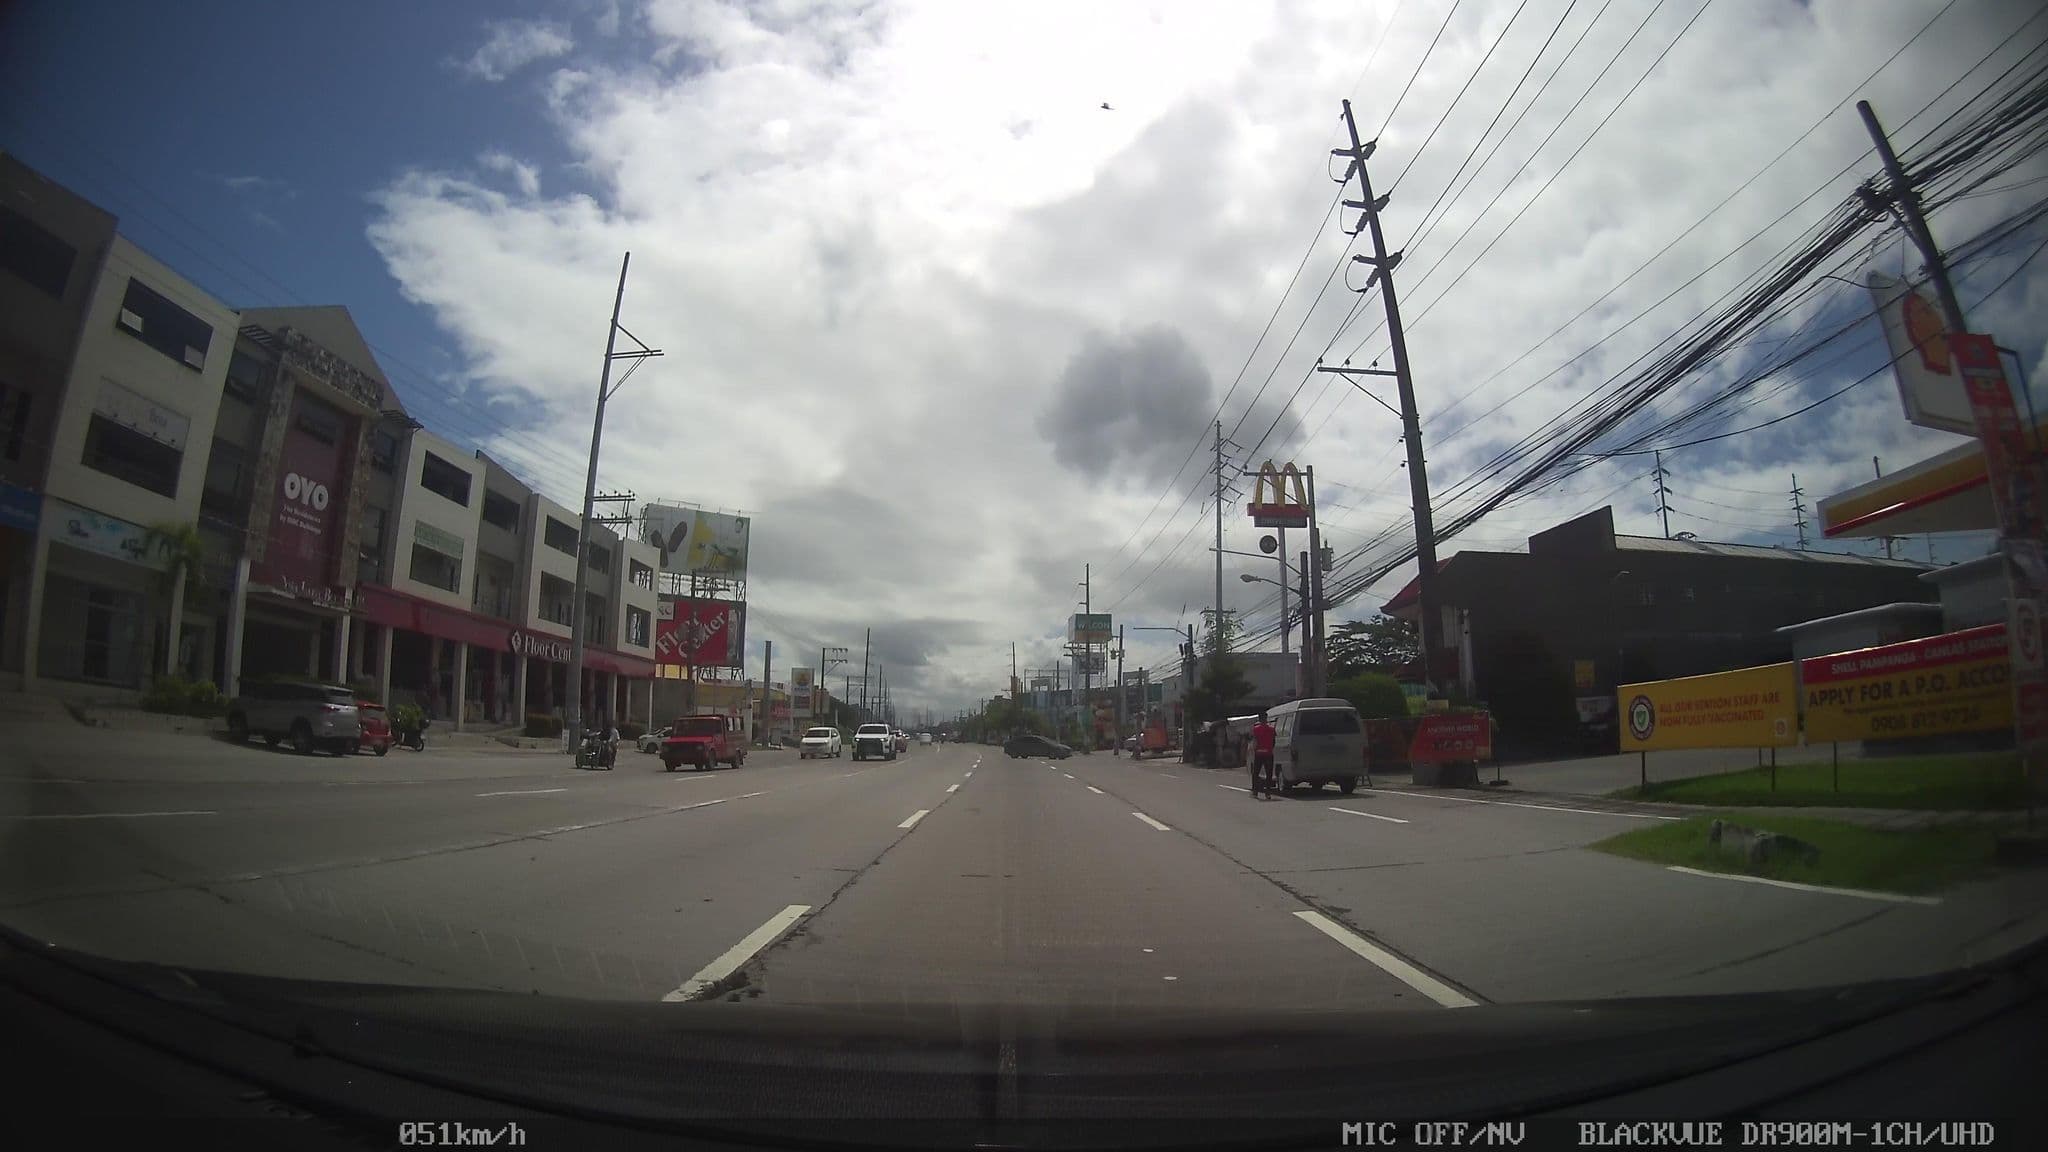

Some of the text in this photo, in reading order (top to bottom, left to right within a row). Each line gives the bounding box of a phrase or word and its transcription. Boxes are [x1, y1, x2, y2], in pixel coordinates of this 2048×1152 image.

[284, 472, 329, 511] OYO
[678, 612, 726, 659] Ceter
[1077, 622, 1110, 630] WLCON
[524, 635, 573, 663] Floor Cent
[1831, 661, 1857, 674] SHELL
[1762, 691, 1780, 704] ARE
[1808, 686, 1854, 707] APPLY
[1860, 682, 1893, 702] FOR
[1899, 680, 1910, 696] A
